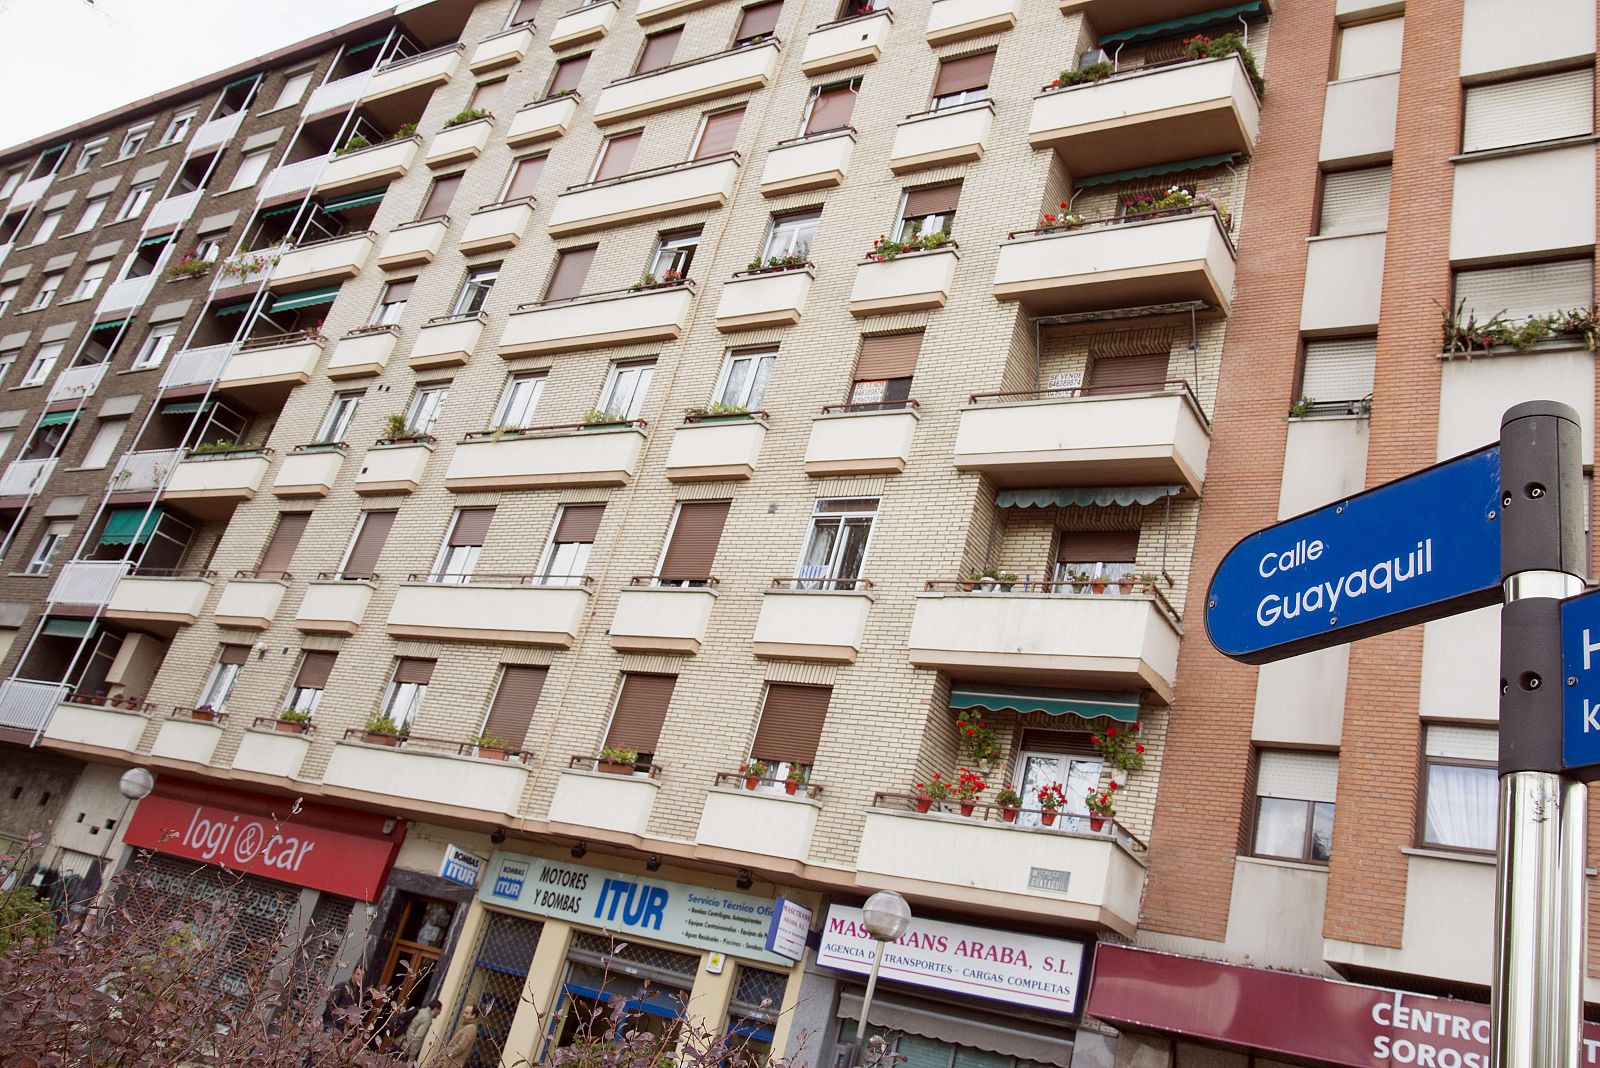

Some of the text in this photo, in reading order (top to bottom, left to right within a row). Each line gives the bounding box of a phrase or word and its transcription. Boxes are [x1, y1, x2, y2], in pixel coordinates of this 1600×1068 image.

[1259, 540, 1324, 578] Calle
[1256, 538, 1432, 627] Guayaquil
[454, 851, 479, 867] BOMBAS
[503, 866, 525, 876] BOMBAS
[447, 862, 476, 885] ITUR
[539, 866, 589, 890] MOTORES
[496, 881, 520, 896] ITUR
[534, 889, 582, 914] Y BOMBAS
[594, 878, 669, 931] ITUR
[688, 893, 774, 917] Servicio Técnico Ofic
[825, 943, 865, 958] AGENCIA
[884, 953, 953, 973] TRANSPORTES
[962, 968, 1004, 983] CARGAS
[1007, 976, 1071, 995] COMPLETAS
[954, 940, 1033, 970] ARABA,
[1042, 956, 1073, 975] S.L.
[1372, 991, 1490, 1044] CENTRO
